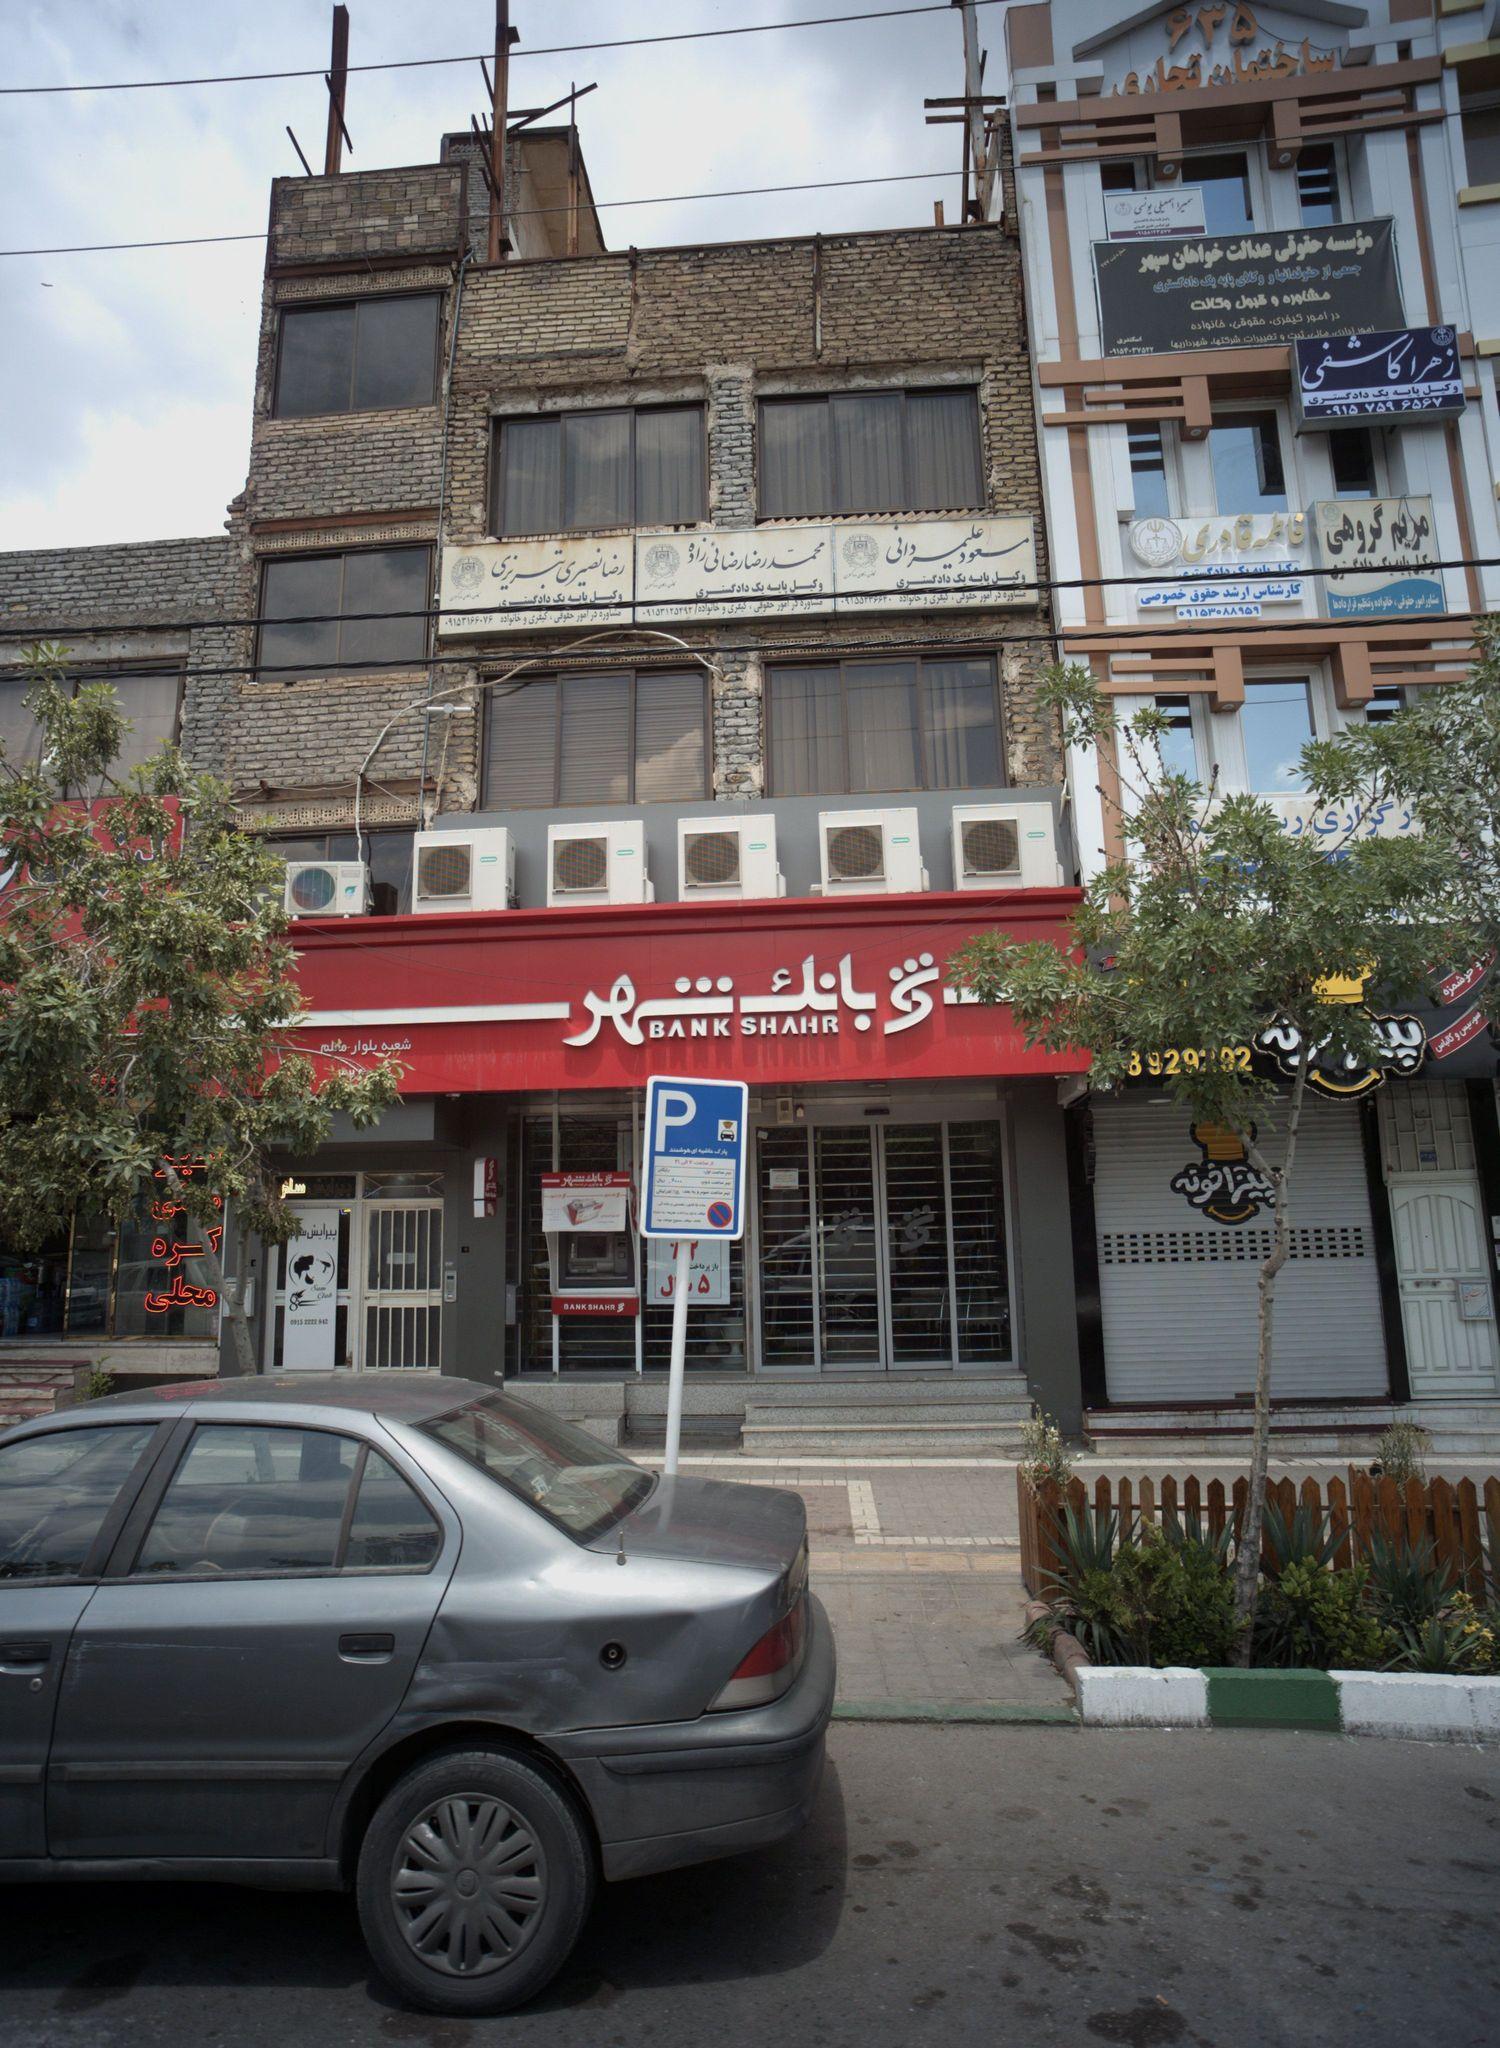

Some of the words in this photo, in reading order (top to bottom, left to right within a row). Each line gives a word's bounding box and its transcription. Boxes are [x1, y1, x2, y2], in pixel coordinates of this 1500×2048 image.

[1226, 239, 1272, 262] عدالت
[1274, 234, 1323, 262] حقوقی
[1138, 253, 1170, 273] سپهر
[1172, 242, 1224, 270] خواهان
[1322, 264, 1332, 280] از
[1200, 274, 1216, 289] یک
[1217, 272, 1234, 288] پایه
[1190, 296, 1232, 311] وکالت
[1235, 294, 1268, 309] قبول
[1270, 295, 1279, 308] و
[1282, 288, 1332, 306] مشاوره
[1306, 311, 1328, 324] امور
[1330, 312, 1340, 321] در
[1190, 319, 1226, 330] خانواده
[1170, 338, 1208, 350] شهرداریها
[1244, 334, 1278, 344] تغییرات
[1301, 333, 1414, 390] کاشفی
[1410, 348, 1454, 384] زهرا
[1372, 388, 1389, 400] یک
[1392, 388, 1420, 398] پایه
[1422, 382, 1459, 396] وکیل
[1308, 392, 1370, 406] دادگستری
[1252, 512, 1306, 548] فاطمه
[1326, 503, 1384, 556] گروهی
[1391, 512, 1430, 552] مریم
[1182, 514, 1254, 563] قادری
[959, 536, 1030, 564] مسعود
[556, 548, 603, 586] نصیری
[601, 554, 626, 578] رضا
[746, 550, 768, 570] رضا
[491, 549, 566, 590] تبریزی
[992, 570, 1026, 584] وکیل
[896, 574, 950, 588] دادگستری
[952, 572, 966, 584] یک
[968, 572, 990, 584] پایه
[696, 582, 749, 598] دادگستری
[752, 582, 766, 594] یک
[767, 582, 788, 594] پایه
[790, 579, 824, 593] وکیل
[1222, 586, 1250, 601] ارشد
[1253, 583, 1302, 600] کارشناس
[498, 593, 551, 608] دادگستری
[552, 592, 566, 604] یک
[567, 592, 589, 604] پایه
[590, 590, 623, 603] وکیل
[1140, 589, 1186, 606] خصوصی
[1190, 588, 1220, 603] حقوق
[576, 610, 589, 622] امور
[590, 612, 598, 622] در
[722, 606, 726, 614] و
[1178, 606, 1260, 618] ۰۹۱۵۳۰۸۸۹۵۹
[500, 614, 522, 626] خانواده
[523, 617, 528, 626] و
[528, 612, 548, 626] کیفری
[740, 952, 876, 1032] بانک
[564, 973, 734, 1046] شهر
[648, 1016, 732, 1038] BANK
[740, 1014, 840, 1036] SHAHR
[1435, 1032, 1455, 1054] کالباس
[1454, 1032, 1461, 1040] و
[351, 1040, 378, 1055] بلوار
[380, 1038, 412, 1052] شعبه
[654, 1089, 696, 1152] P
[714, 1148, 728, 1156] پارک
[560, 1174, 585, 1187] شهر
[585, 1172, 603, 1187] بانک
[1175, 1162, 1223, 1204] خونه
[306, 1223, 337, 1240] پیرایش
[152, 1226, 222, 1266] کره
[698, 1272, 710, 1294] ۵
[144, 1275, 216, 1312] محلی
[563, 1303, 587, 1311] BANK
